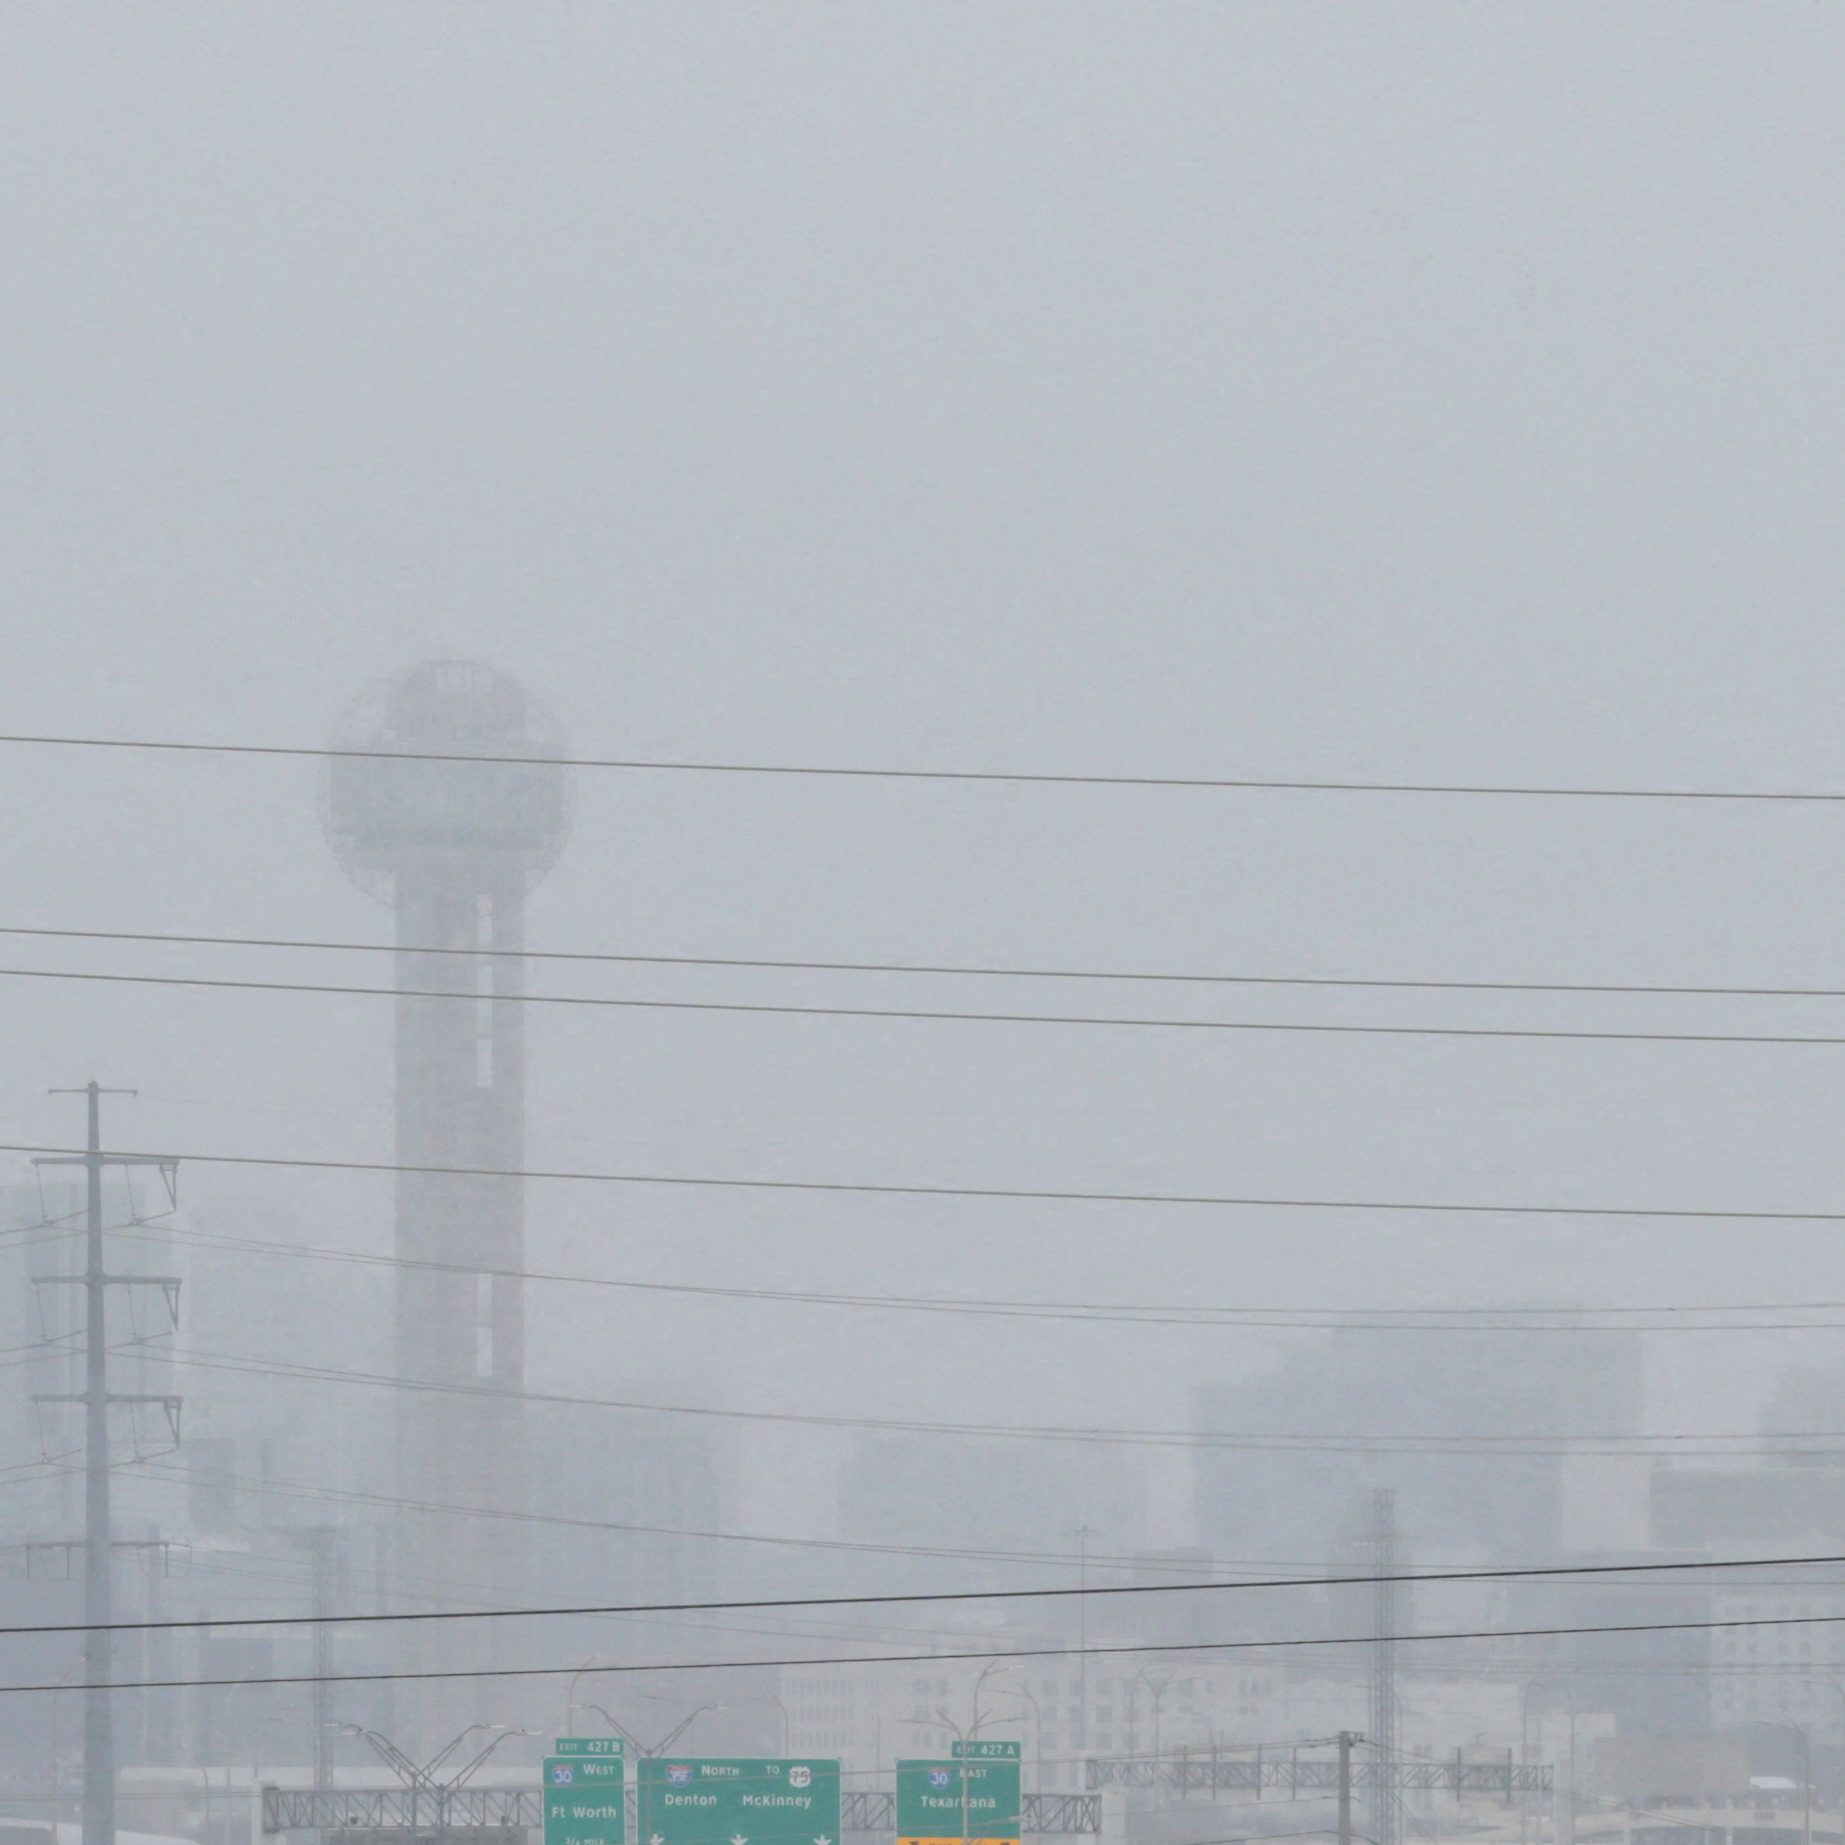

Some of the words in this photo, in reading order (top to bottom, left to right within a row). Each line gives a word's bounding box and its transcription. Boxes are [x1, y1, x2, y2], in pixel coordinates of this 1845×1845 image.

[559, 1743, 578, 1751] EXIT
[587, 1741, 609, 1752] 427
[612, 1741, 621, 1752] B
[957, 1745, 975, 1754] EIT
[980, 1744, 1003, 1755] 427
[1006, 1744, 1015, 1755] A
[555, 1770, 571, 1782] 30
[668, 1770, 688, 1781] 35E
[766, 1765, 780, 1774] TO
[791, 1770, 809, 1783] 75
[931, 1772, 948, 1785] 30
[665, 1794, 717, 1806] Denton
[742, 1794, 812, 1810] McKinney
[552, 1806, 565, 1818] Ft
[573, 1806, 617, 1818] Worth
